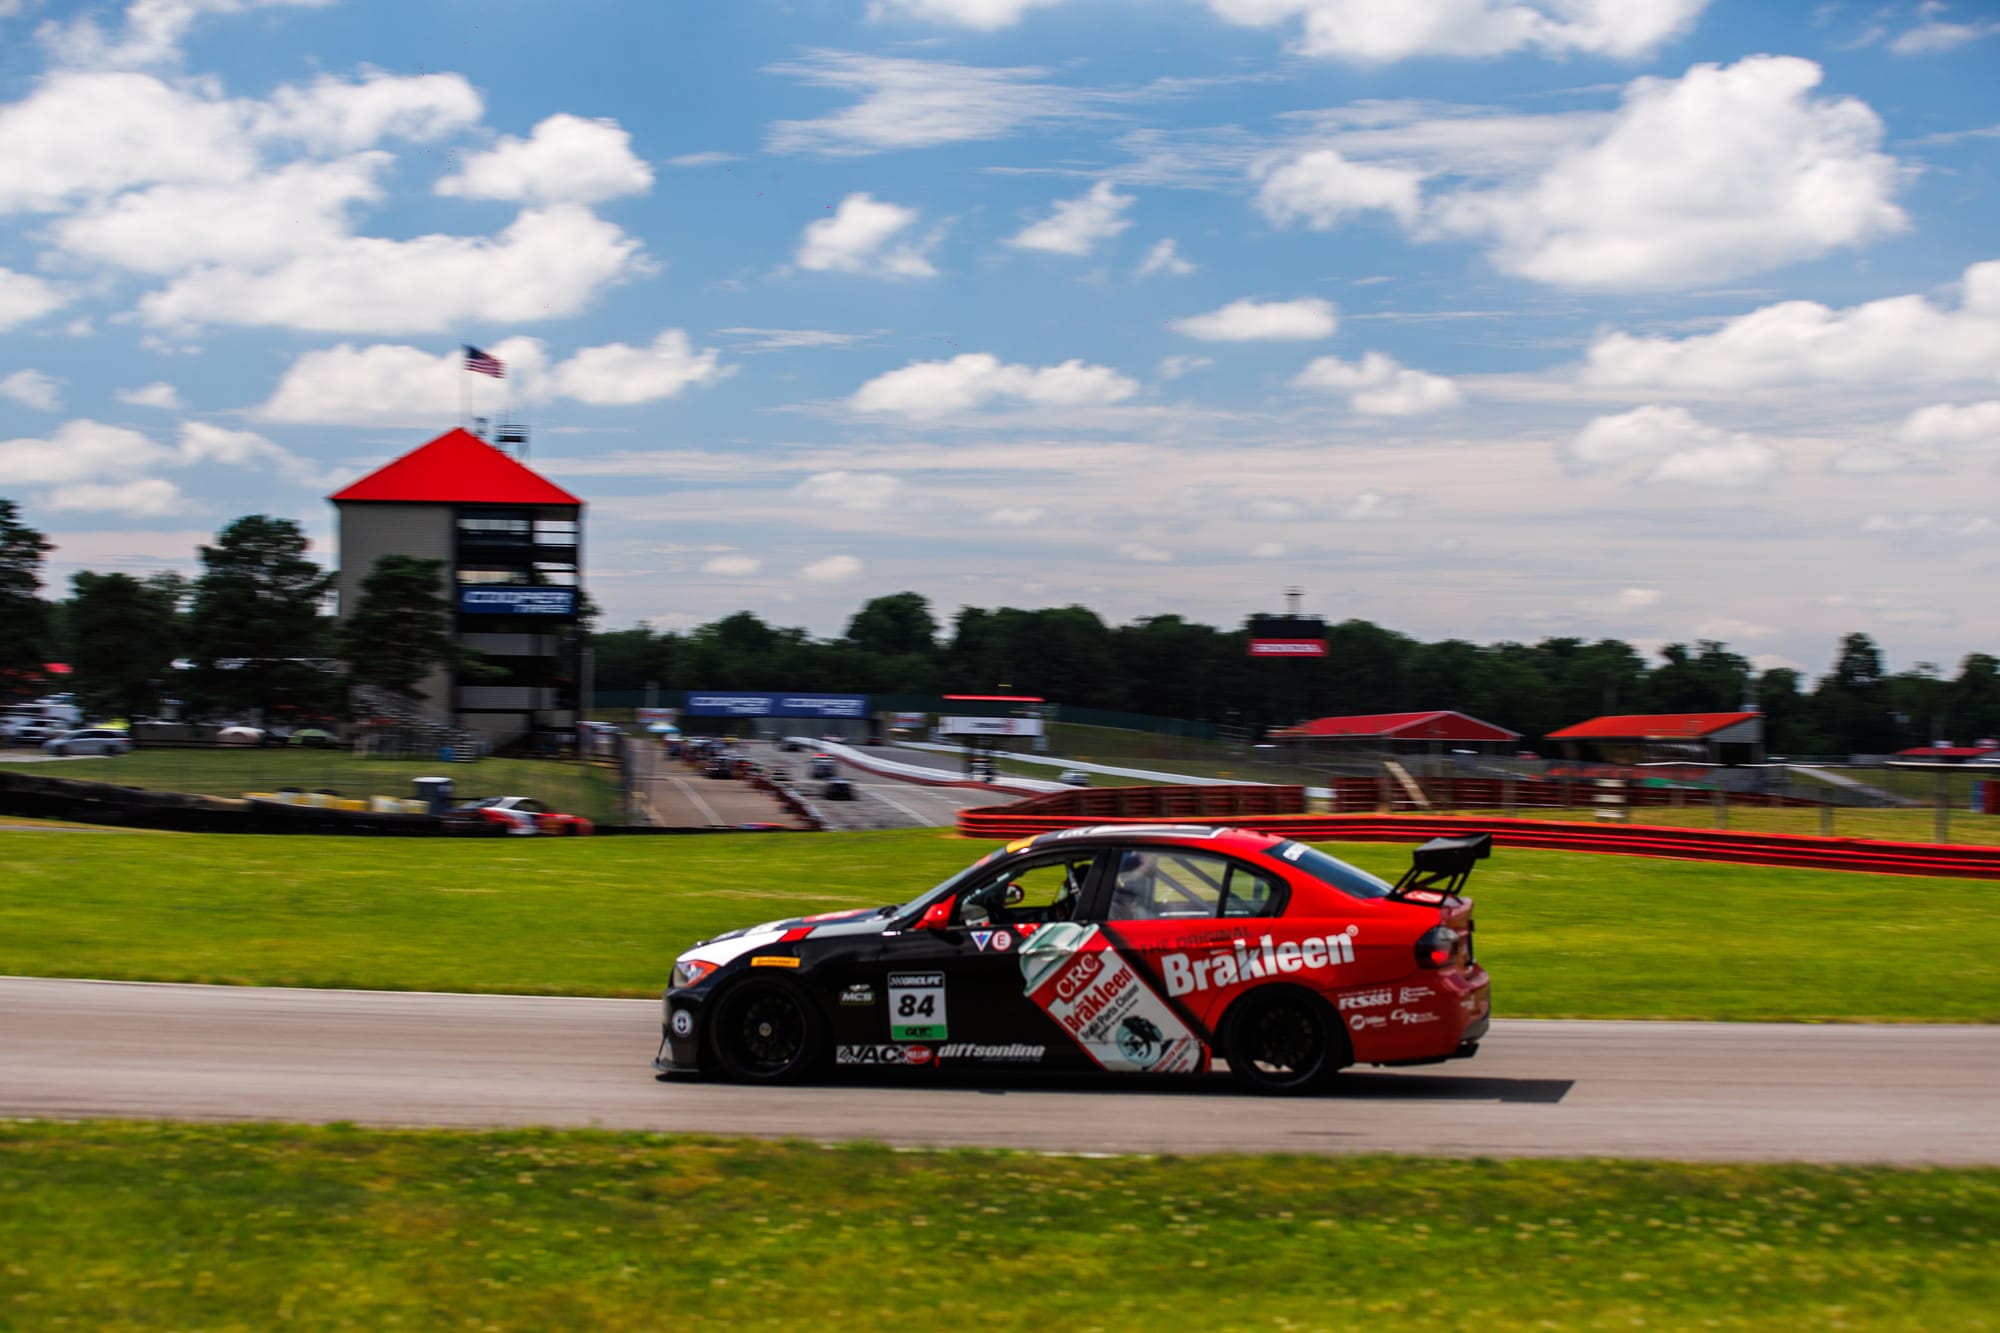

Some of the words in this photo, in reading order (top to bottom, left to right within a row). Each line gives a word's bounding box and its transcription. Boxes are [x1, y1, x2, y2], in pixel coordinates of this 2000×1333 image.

[1055, 952, 1100, 998] CRC
[898, 994, 935, 1018] 84
[937, 1043, 1045, 1058] diffsonline
